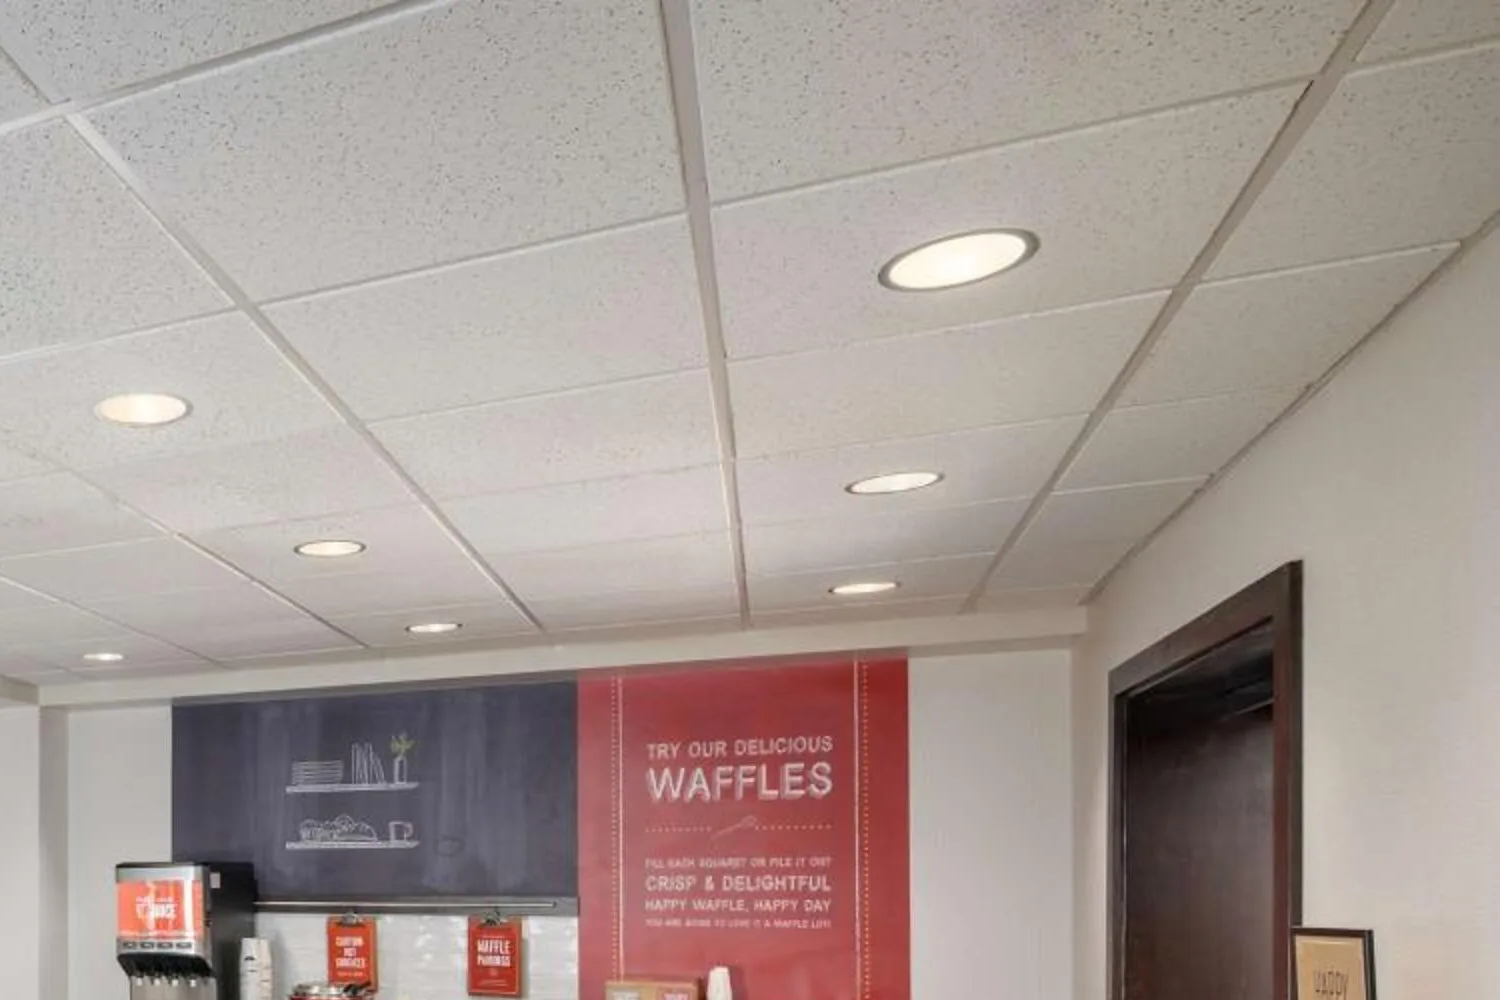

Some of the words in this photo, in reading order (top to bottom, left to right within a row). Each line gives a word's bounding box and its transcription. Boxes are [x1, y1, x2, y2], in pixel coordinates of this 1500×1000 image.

[647, 743, 681, 760] TRY
[688, 740, 727, 758] OUR
[734, 735, 833, 756] DELICIOUS
[646, 761, 833, 802] WAFFLES
[645, 875, 696, 892] CRISP
[705, 875, 715, 891] &
[722, 875, 832, 891] DELIGHTFUL
[645, 899, 687, 912] HAPPY
[692, 899, 749, 912] WAFFLE,
[754, 899, 798, 912] HAPPY
[804, 899, 832, 912] DAY
[477, 939, 511, 954] WAFFLE
[1315, 970, 1348, 1000] HAPPY
